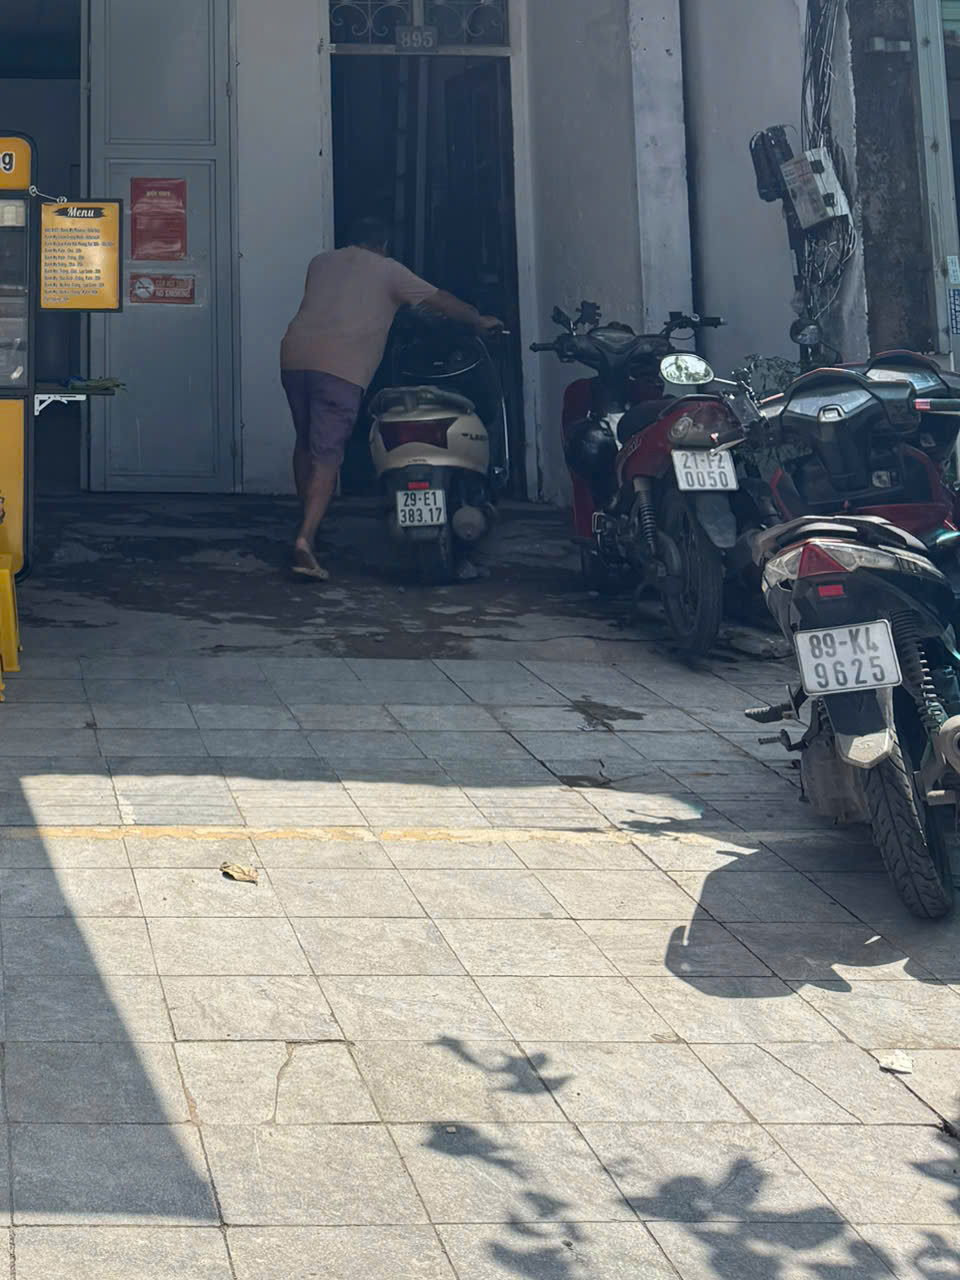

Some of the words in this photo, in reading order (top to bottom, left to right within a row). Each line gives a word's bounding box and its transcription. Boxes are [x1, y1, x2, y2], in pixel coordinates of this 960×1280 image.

[401, 32, 433, 48] 895
[67, 207, 95, 217] Menu
[685, 471, 729, 487] 0050
[809, 627, 879, 659] 89-K4
[814, 656, 885, 688] 9625
